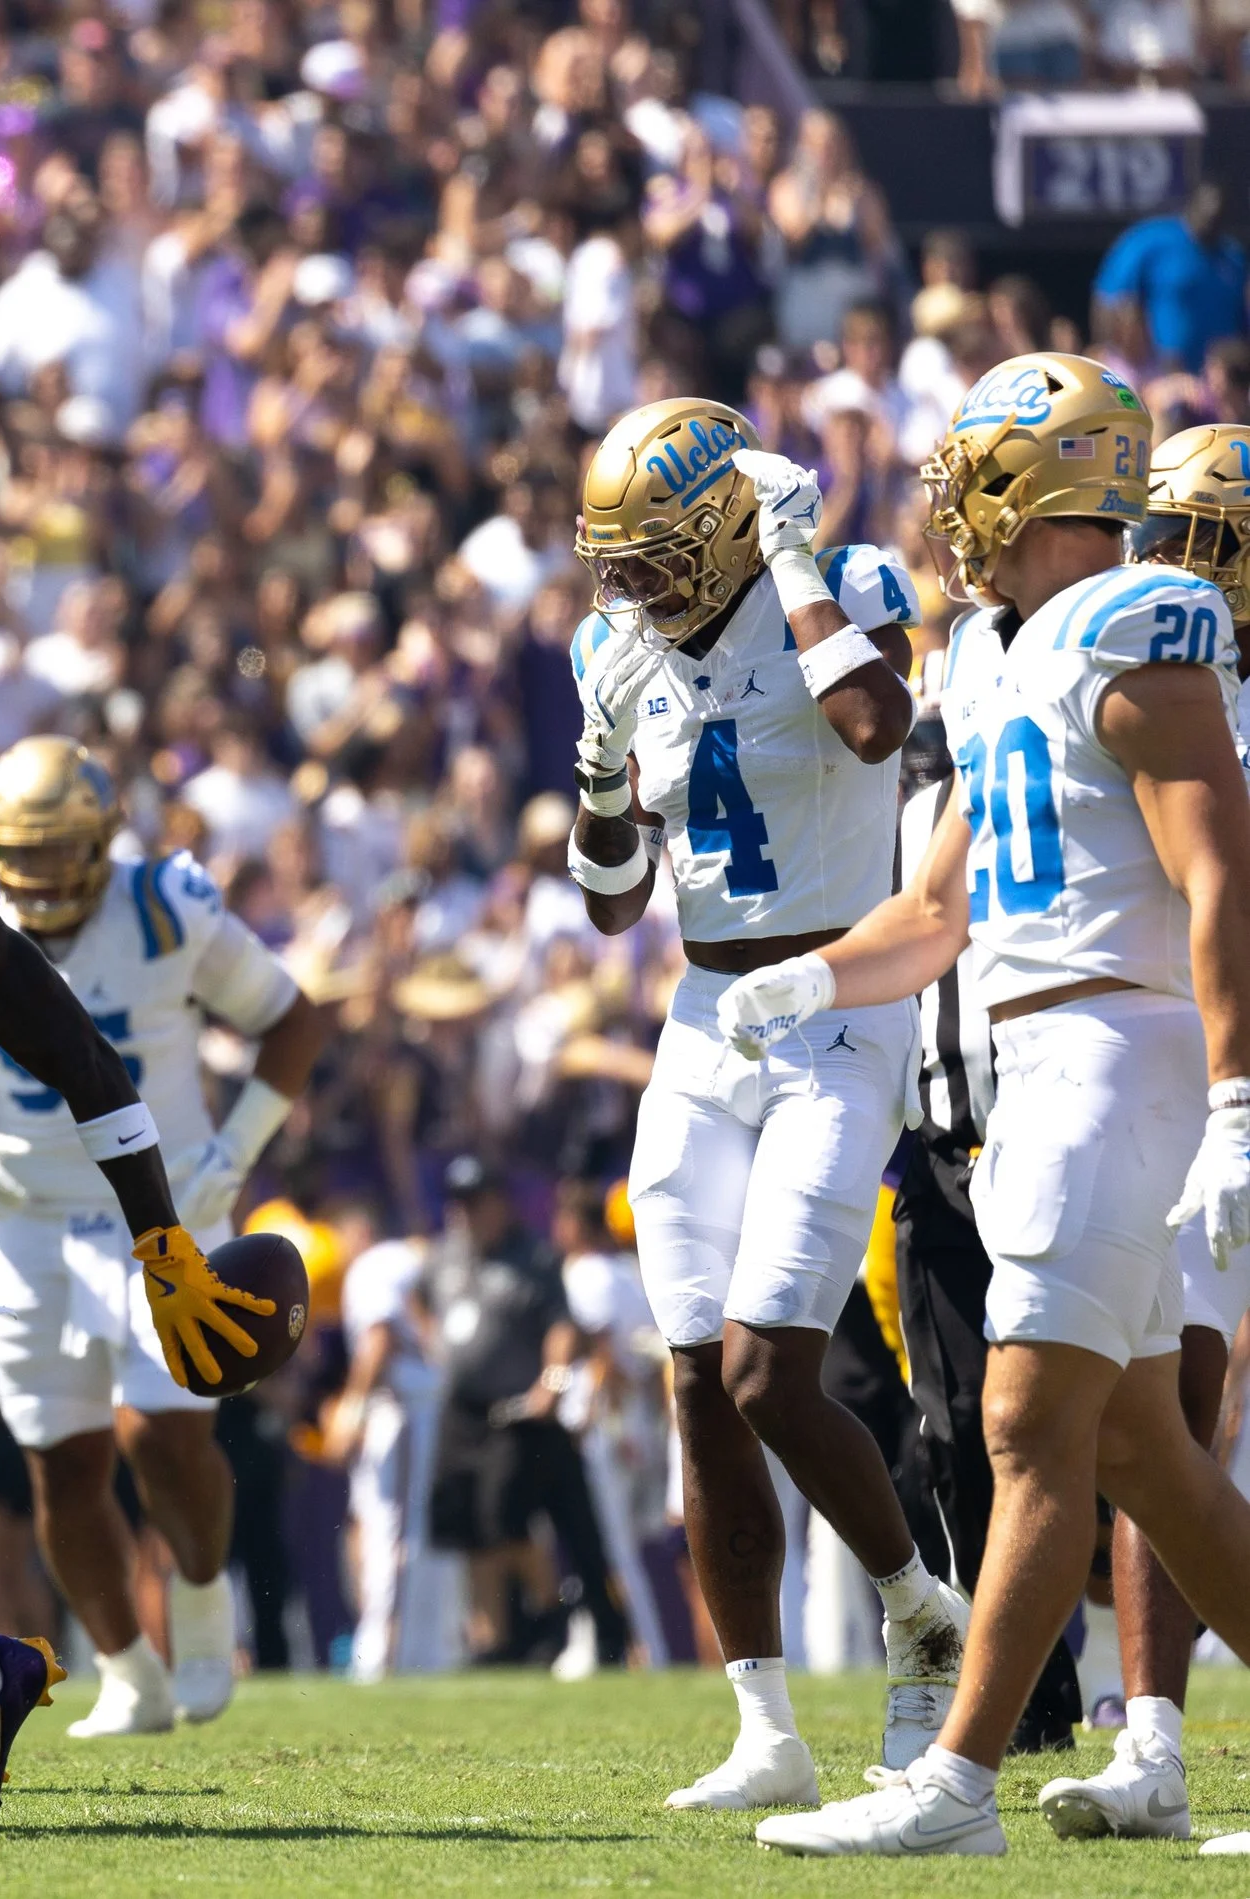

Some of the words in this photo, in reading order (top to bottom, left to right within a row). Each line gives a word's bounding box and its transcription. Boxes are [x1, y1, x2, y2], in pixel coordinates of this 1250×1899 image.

[647, 420, 748, 500] Ucla
[1115, 435, 1147, 478] 20
[878, 564, 911, 621] 4
[1150, 603, 1217, 664] 20
[685, 718, 779, 899] 4
